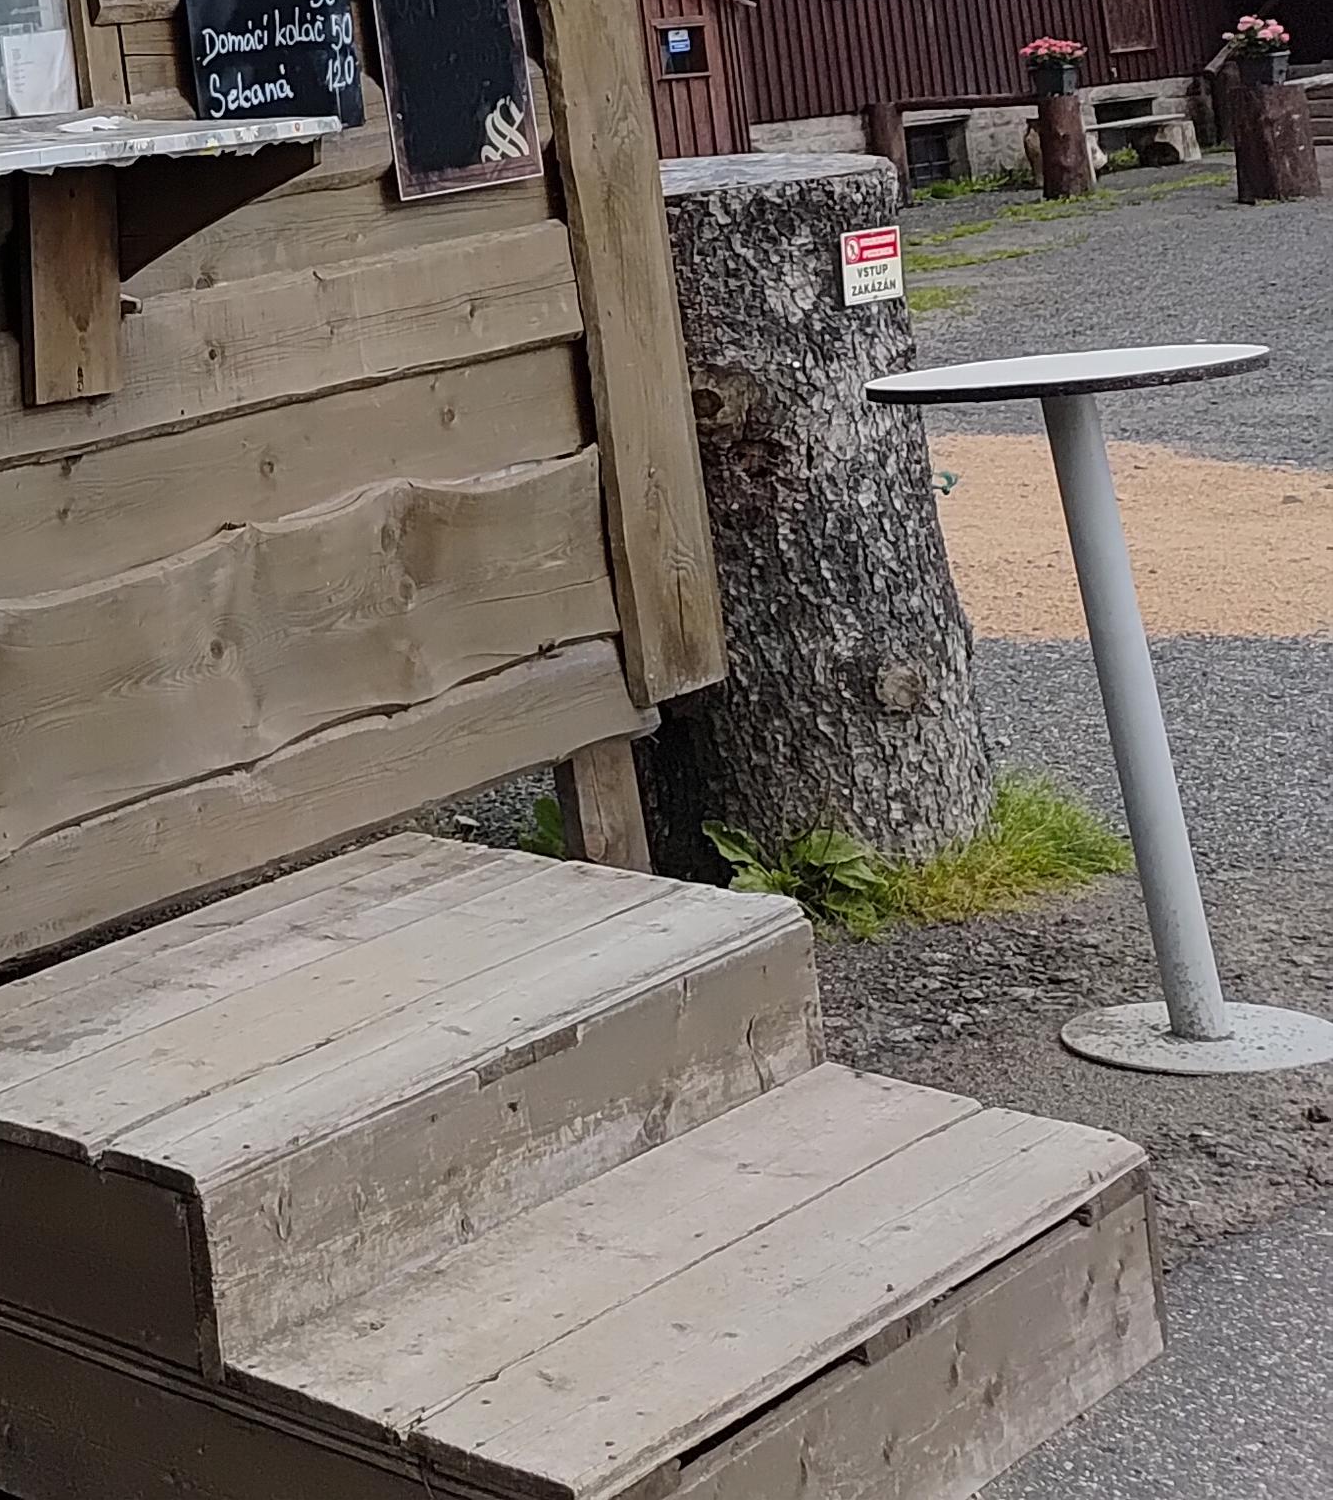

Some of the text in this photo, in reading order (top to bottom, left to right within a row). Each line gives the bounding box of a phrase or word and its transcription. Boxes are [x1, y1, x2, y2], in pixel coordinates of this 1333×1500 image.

[201, 6, 353, 66] Domácí koláč 50
[209, 55, 355, 118] Sekaná 120
[851, 277, 896, 297] ZAKÁZÁN
[857, 264, 889, 278] VSTUP
